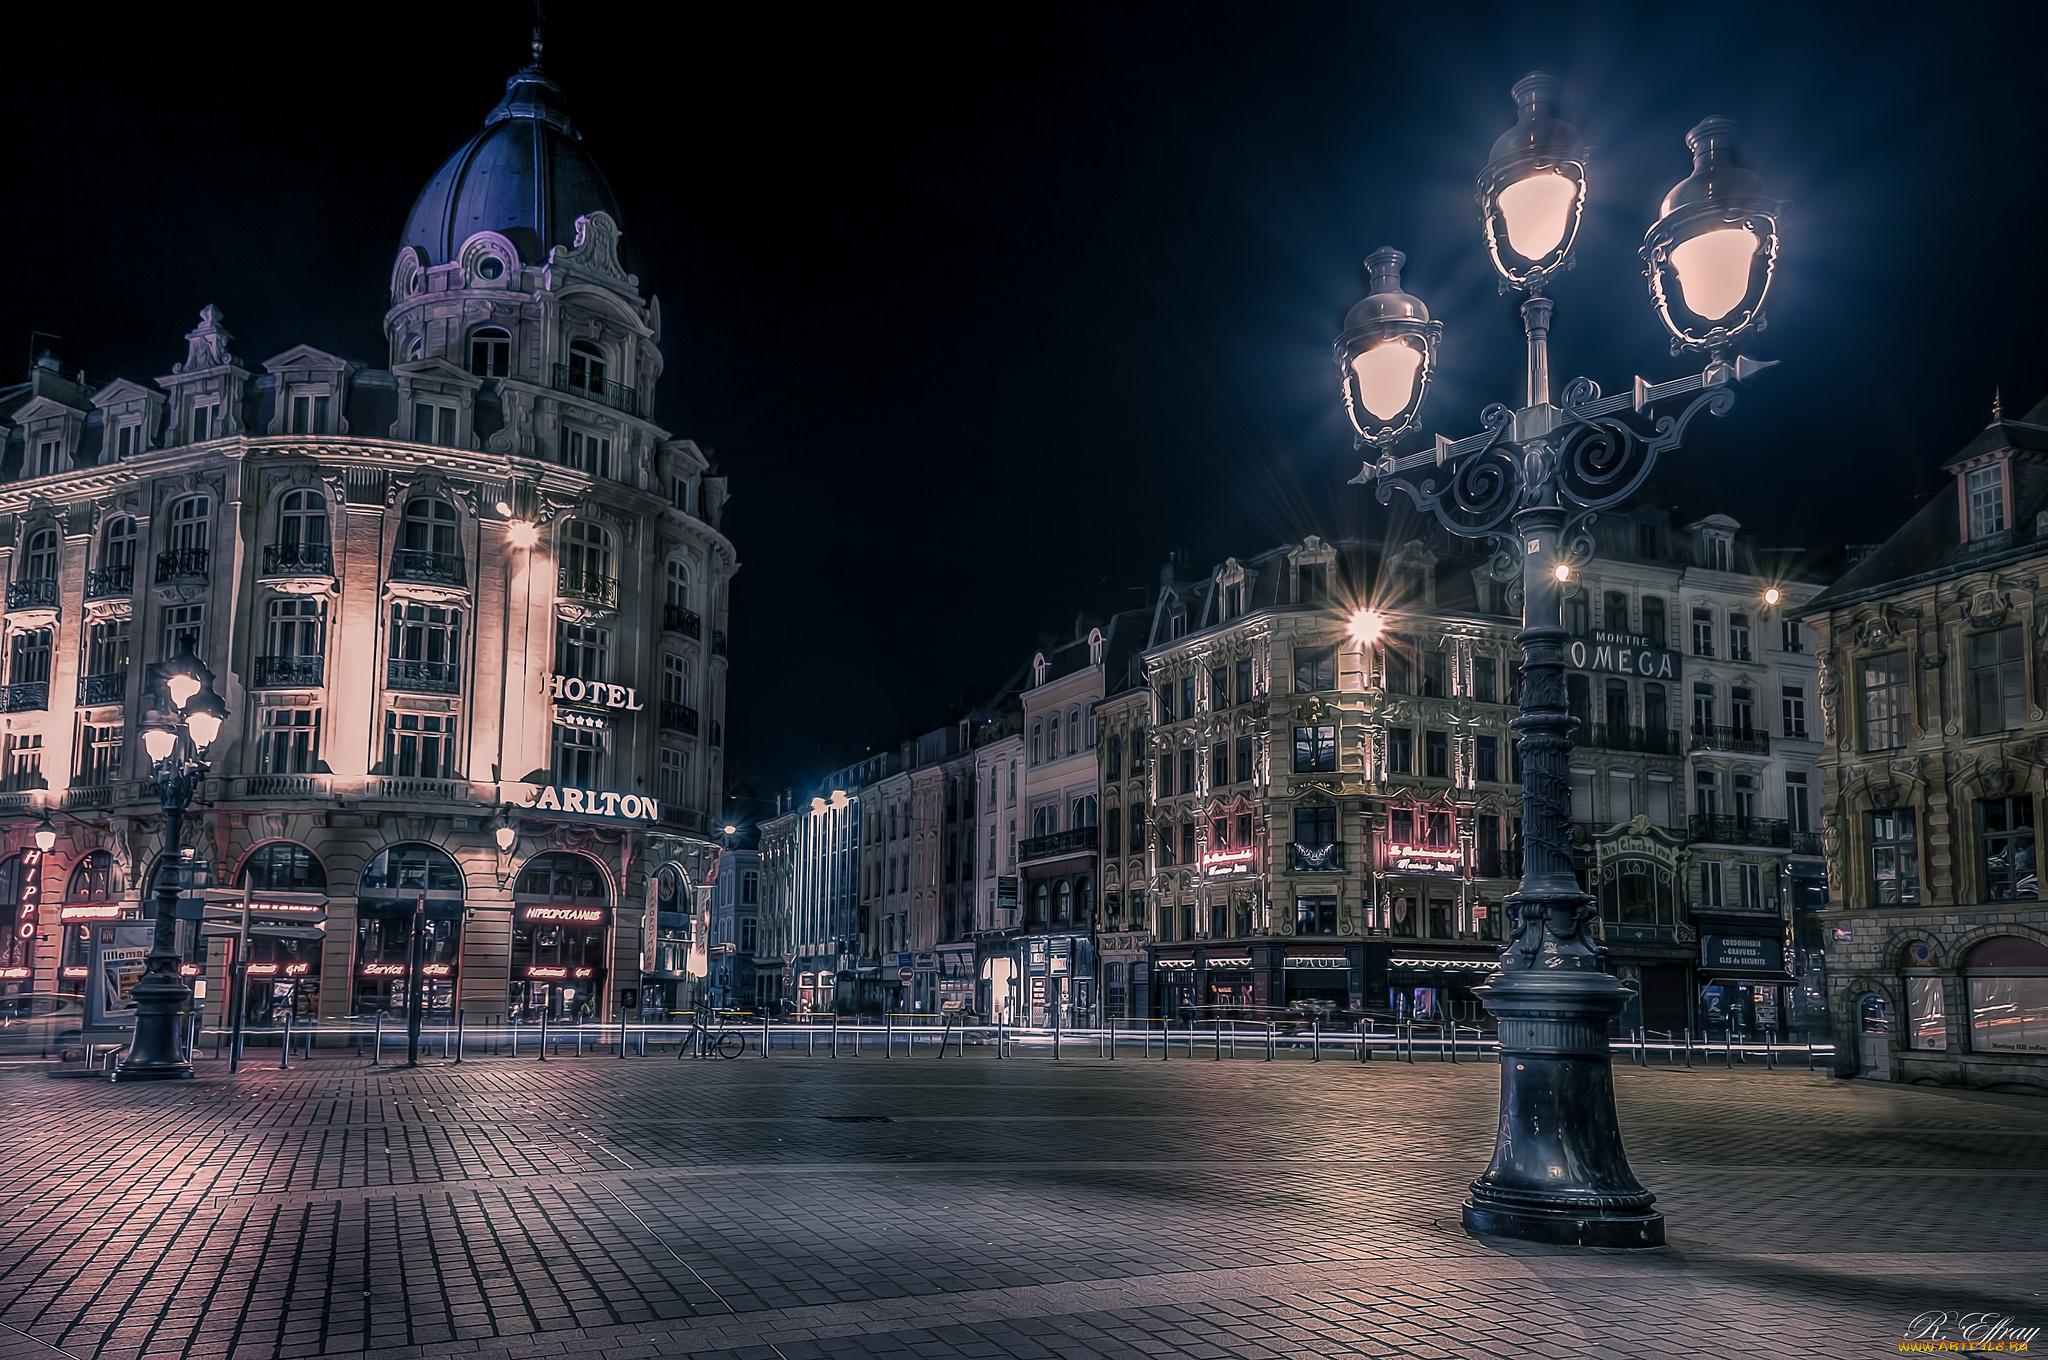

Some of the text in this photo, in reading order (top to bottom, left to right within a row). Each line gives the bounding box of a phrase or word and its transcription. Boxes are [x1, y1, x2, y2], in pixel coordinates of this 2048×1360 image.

[1596, 631, 1649, 647] MONTRE
[1571, 641, 1673, 678] OMEGA
[541, 672, 644, 711] HOTEL
[514, 785, 660, 821] CARLTON
[20, 850, 41, 938] HIPPO
[1722, 939, 1762, 948] CORDONNERIE
[1727, 948, 1757, 956] GRAVURES
[1295, 958, 1341, 968] PAUL
